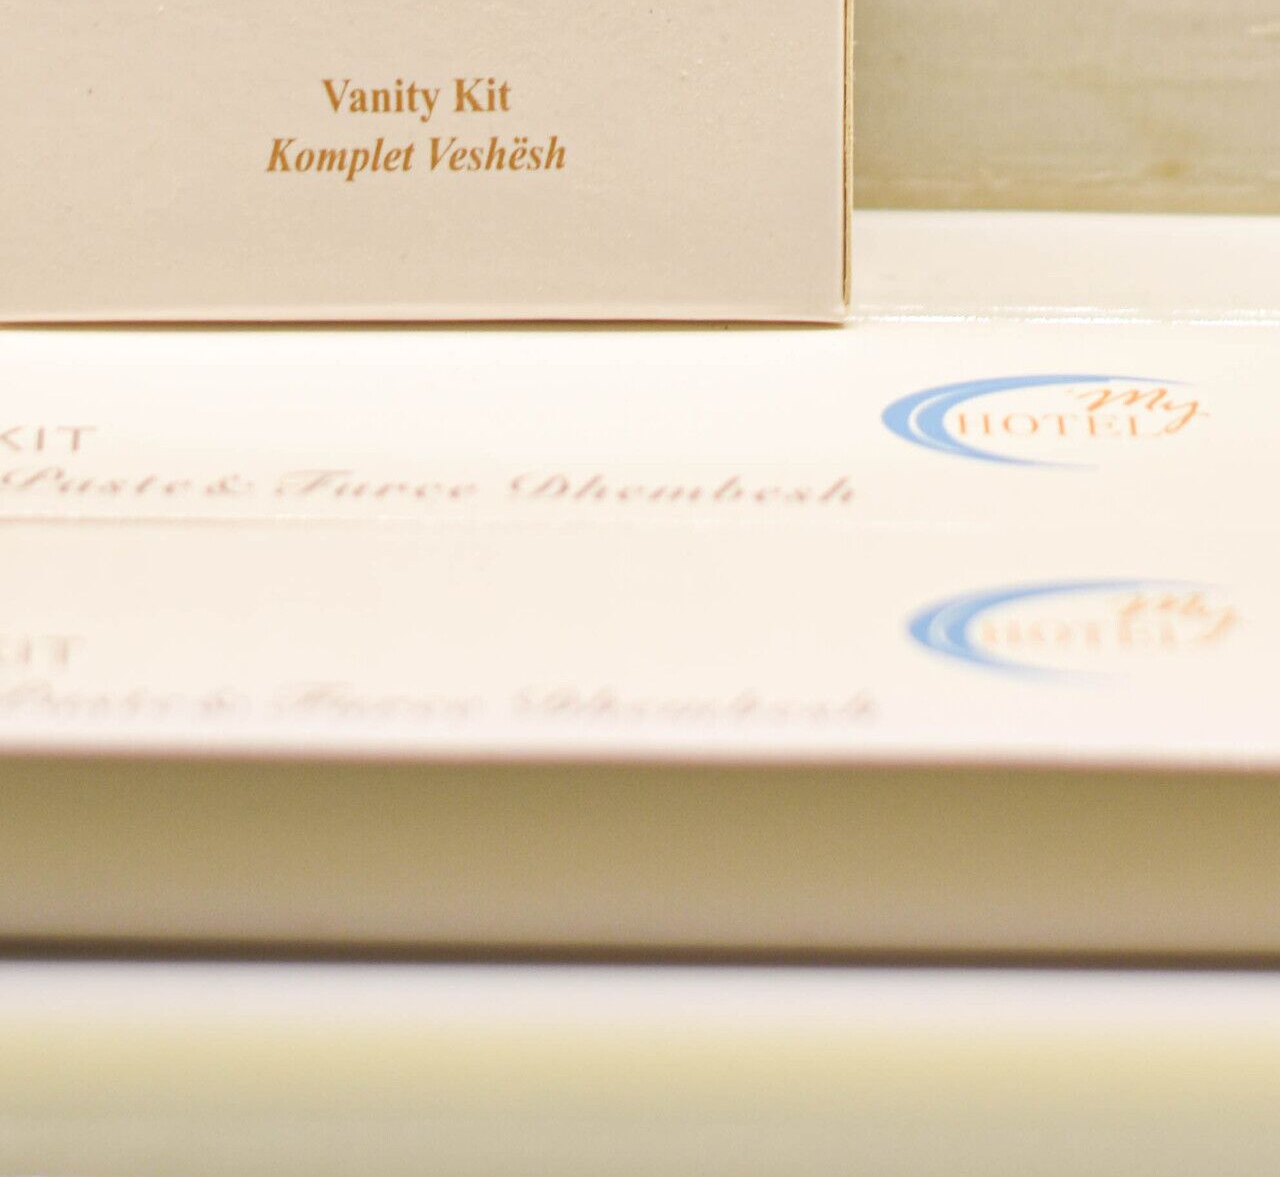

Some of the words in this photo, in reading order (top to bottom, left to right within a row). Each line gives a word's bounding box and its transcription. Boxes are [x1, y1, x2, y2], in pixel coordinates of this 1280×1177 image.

[322, 77, 441, 123] Vanity
[453, 76, 512, 113] Kit
[266, 136, 415, 182] Komplet
[428, 134, 567, 172] Veshësh
[956, 411, 1164, 438] HOTEL
[1071, 387, 1211, 435] My
